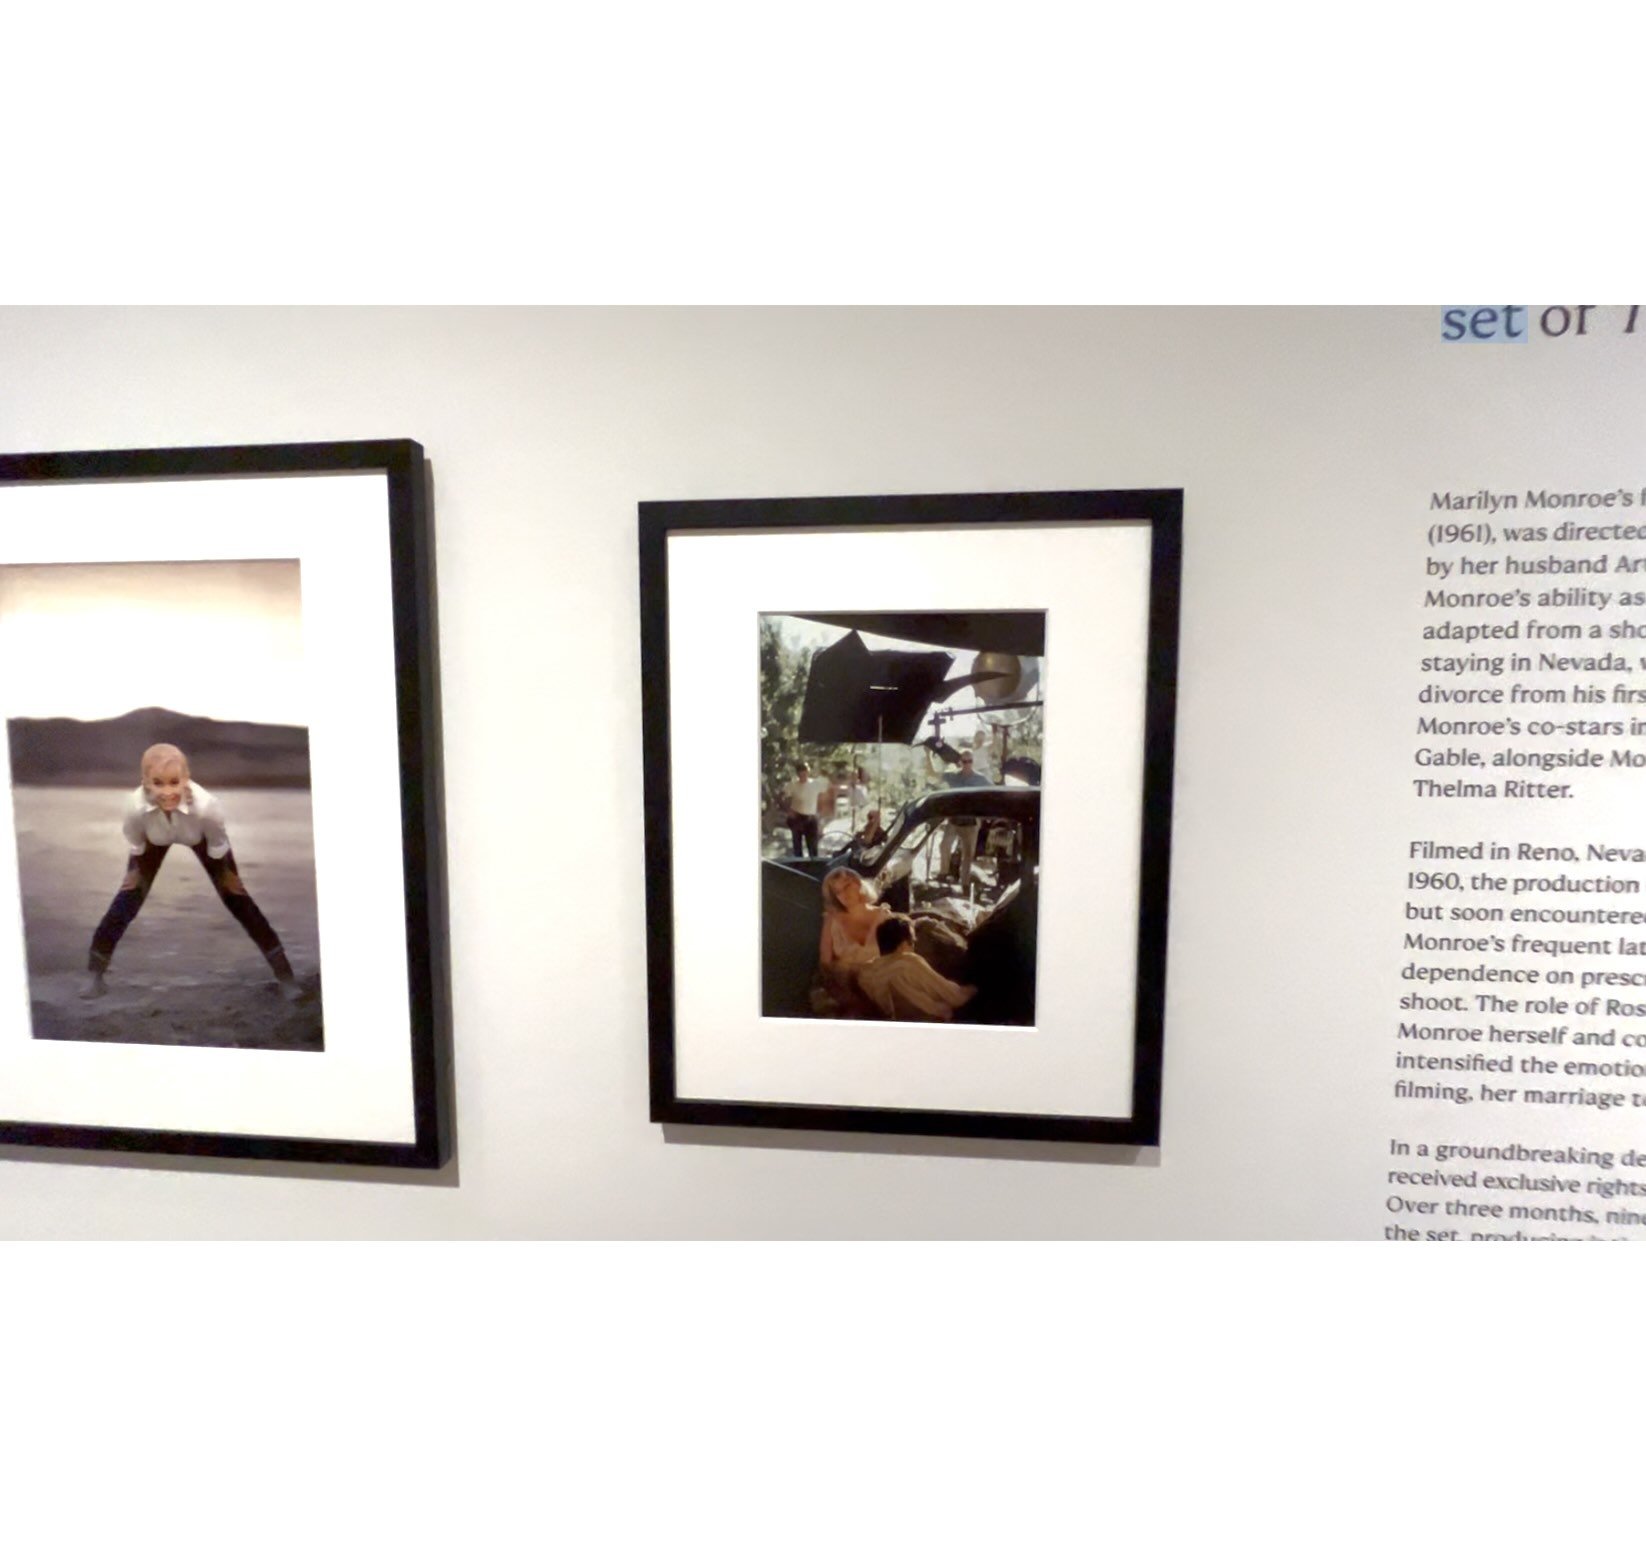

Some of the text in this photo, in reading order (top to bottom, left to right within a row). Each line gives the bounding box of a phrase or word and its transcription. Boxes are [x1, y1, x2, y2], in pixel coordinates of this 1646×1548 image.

[1442, 305, 1524, 340] set
[1430, 491, 1517, 514] Marilyn
[1524, 489, 1633, 508] Monroe's
[1428, 523, 1496, 547] (1961),
[1503, 527, 1547, 542] was
[1426, 557, 1453, 580] by
[1460, 556, 1498, 575] her
[1505, 555, 1607, 574] husband
[1424, 588, 1646, 610] Monroe's ability as
[1423, 620, 1519, 643] adapted
[1526, 620, 1581, 639] from
[1588, 624, 1602, 639] a
[1421, 653, 1504, 676] staying
[1511, 653, 1530, 671] in
[1539, 653, 1633, 673] Nevada,
[1418, 685, 1504, 703] divorce
[1510, 684, 1565, 703] from
[1573, 685, 1606, 703] his
[1417, 717, 1521, 735] Monroe's
[1527, 719, 1624, 736] co-stars
[1415, 748, 1486, 768] Gable,
[1492, 748, 1604, 771] alongside
[1413, 780, 1573, 799] Thelma Ritter.
[1410, 841, 1483, 860] Filmed
[1490, 842, 1510, 860] in
[1517, 843, 1580, 862] Reno,
[1408, 872, 1639, 895] 1960, the production
[1405, 902, 1443, 920] but
[1450, 906, 1503, 921] soon
[1404, 933, 1505, 952] Monroe's
[1511, 934, 1611, 957] frequent
[1401, 963, 1539, 984] dependence
[1546, 970, 1574, 984] on
[1400, 992, 1468, 1011] shoot.
[1475, 995, 1518, 1013] The
[1525, 997, 1568, 1014] role
[1575, 997, 1600, 1015] of
[1397, 1023, 1482, 1042] Monroe
[1489, 1025, 1568, 1044] herself
[1572, 1029, 1615, 1046] and
[1396, 1052, 1513, 1073] intensified
[1520, 1056, 1558, 1074] the
[1394, 1079, 1473, 1104] filming,
[1480, 1084, 1517, 1103] her
[1524, 1088, 1625, 1110] marriage
[1390, 1139, 1409, 1156] In
[1417, 1144, 1428, 1157] a
[1435, 1145, 1613, 1169] groundbreaking
[1388, 1170, 1646, 1198] received exclusive rights
[1386, 1196, 1438, 1214] Over
[1445, 1200, 1502, 1218] three
[1509, 1205, 1599, 1224] months,
[1384, 1224, 1420, 1241] the
